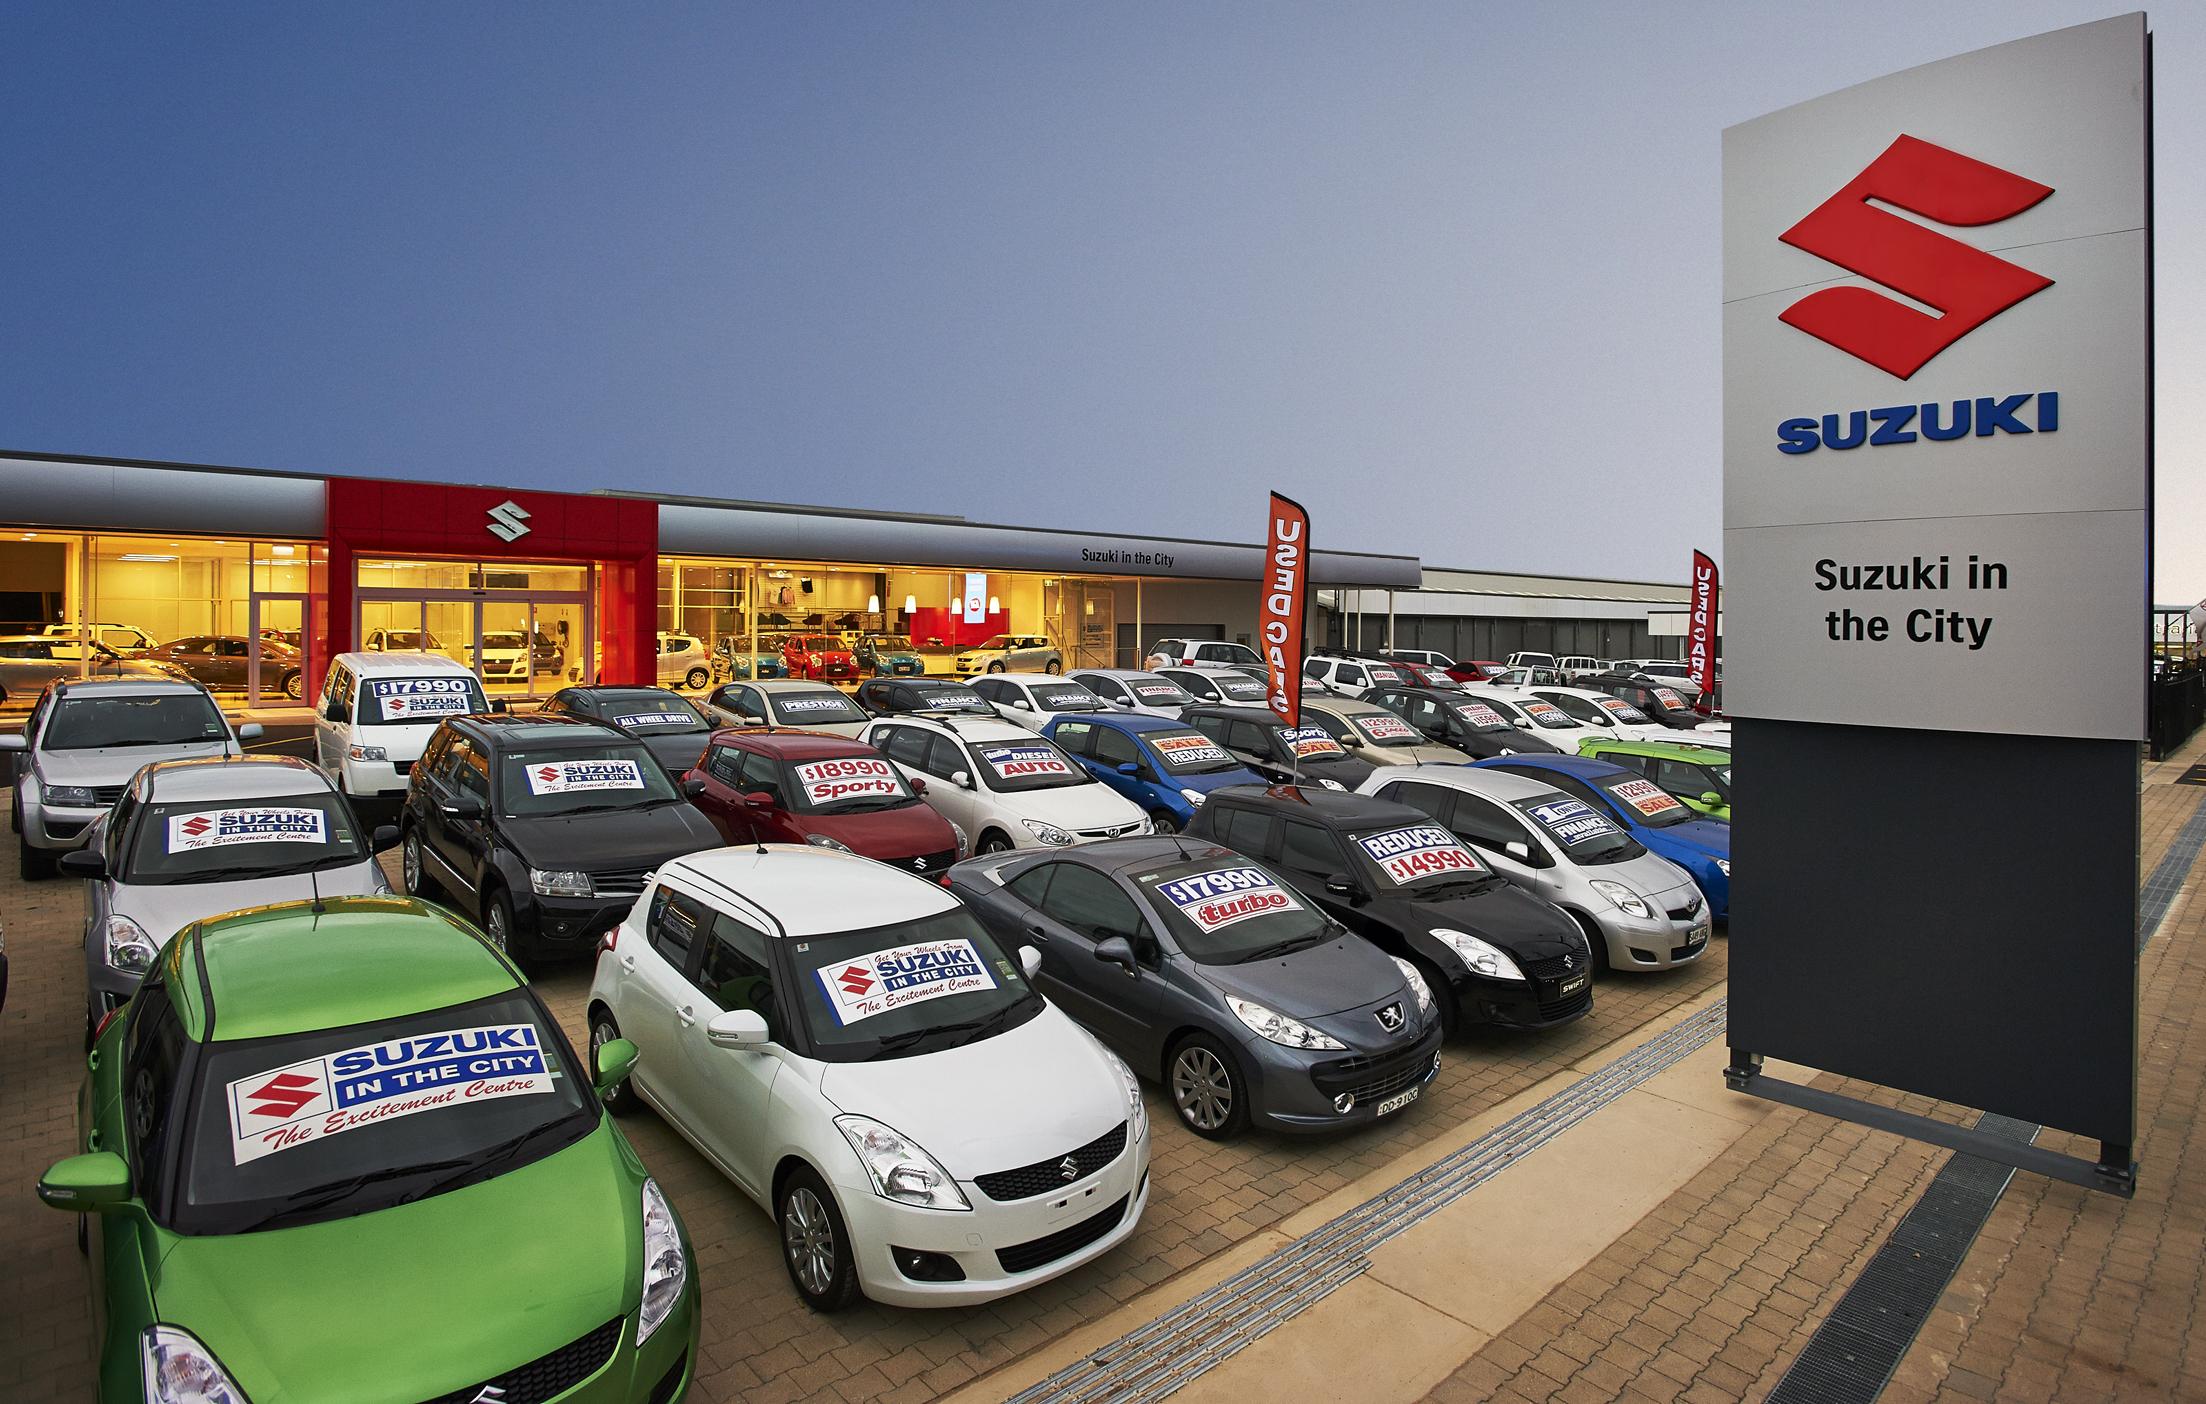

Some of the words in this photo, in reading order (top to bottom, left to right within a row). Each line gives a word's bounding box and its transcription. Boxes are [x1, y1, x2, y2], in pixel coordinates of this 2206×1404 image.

[1776, 391, 2059, 455] SUZUKI
[1081, 548, 1118, 563] Suzuki
[1121, 550, 1132, 563] in
[1134, 551, 1152, 565] the
[1154, 552, 1175, 568] City
[1814, 555, 1949, 591] Suzuki
[1968, 555, 2007, 589] in
[1825, 608, 1889, 642] the
[1906, 608, 1993, 650] City
[379, 680, 466, 694] $17990
[784, 700, 845, 710] PRESTIGE
[620, 716, 637, 727] ALL
[636, 715, 665, 724] WHEEL
[664, 713, 692, 723] DRIVE
[1284, 729, 1328, 740] Sporty
[1372, 729, 1387, 737] 6
[1160, 739, 1210, 750] SALE
[1297, 744, 1341, 755] SALE
[1011, 752, 1057, 760] DIESEL
[1167, 748, 1224, 763] REDUCED
[563, 765, 634, 775] SUZUKI
[805, 761, 888, 780] $18990
[1003, 761, 1066, 776] AUTO
[564, 781, 606, 790] Excitement
[813, 780, 896, 798] Sporty
[1640, 798, 1680, 813] SALE
[219, 814, 318, 826] SUZUKI
[1535, 806, 1560, 824] 1
[279, 823, 312, 832] CITY
[1554, 817, 1609, 838] FINANCE
[185, 840, 207, 849] The
[213, 833, 273, 845] Excitement
[276, 832, 312, 841] Centre
[1364, 828, 1454, 858] REDUCED
[1390, 850, 1476, 878] $14990
[1169, 869, 1269, 901] $17990
[1198, 892, 1290, 926] turbo
[874, 955, 890, 964] Get
[891, 950, 914, 961] Your
[913, 946, 942, 955] Wheels
[943, 943, 964, 952] From
[876, 948, 975, 978] SUZUKI
[890, 977, 905, 989] IN
[914, 971, 940, 984] THE
[944, 965, 975, 978] CITY
[1562, 978, 1585, 993] SWIFT
[856, 1002, 881, 1015] The
[885, 983, 945, 1007] Excitement
[948, 978, 981, 991] Centre
[332, 1028, 536, 1076] SUZUKI
[346, 1080, 382, 1101] IN
[392, 1066, 460, 1088] THE
[469, 1055, 535, 1074] CITY
[262, 1127, 312, 1150] The
[323, 1090, 457, 1135] Excitement
[464, 1078, 536, 1098] Centre
